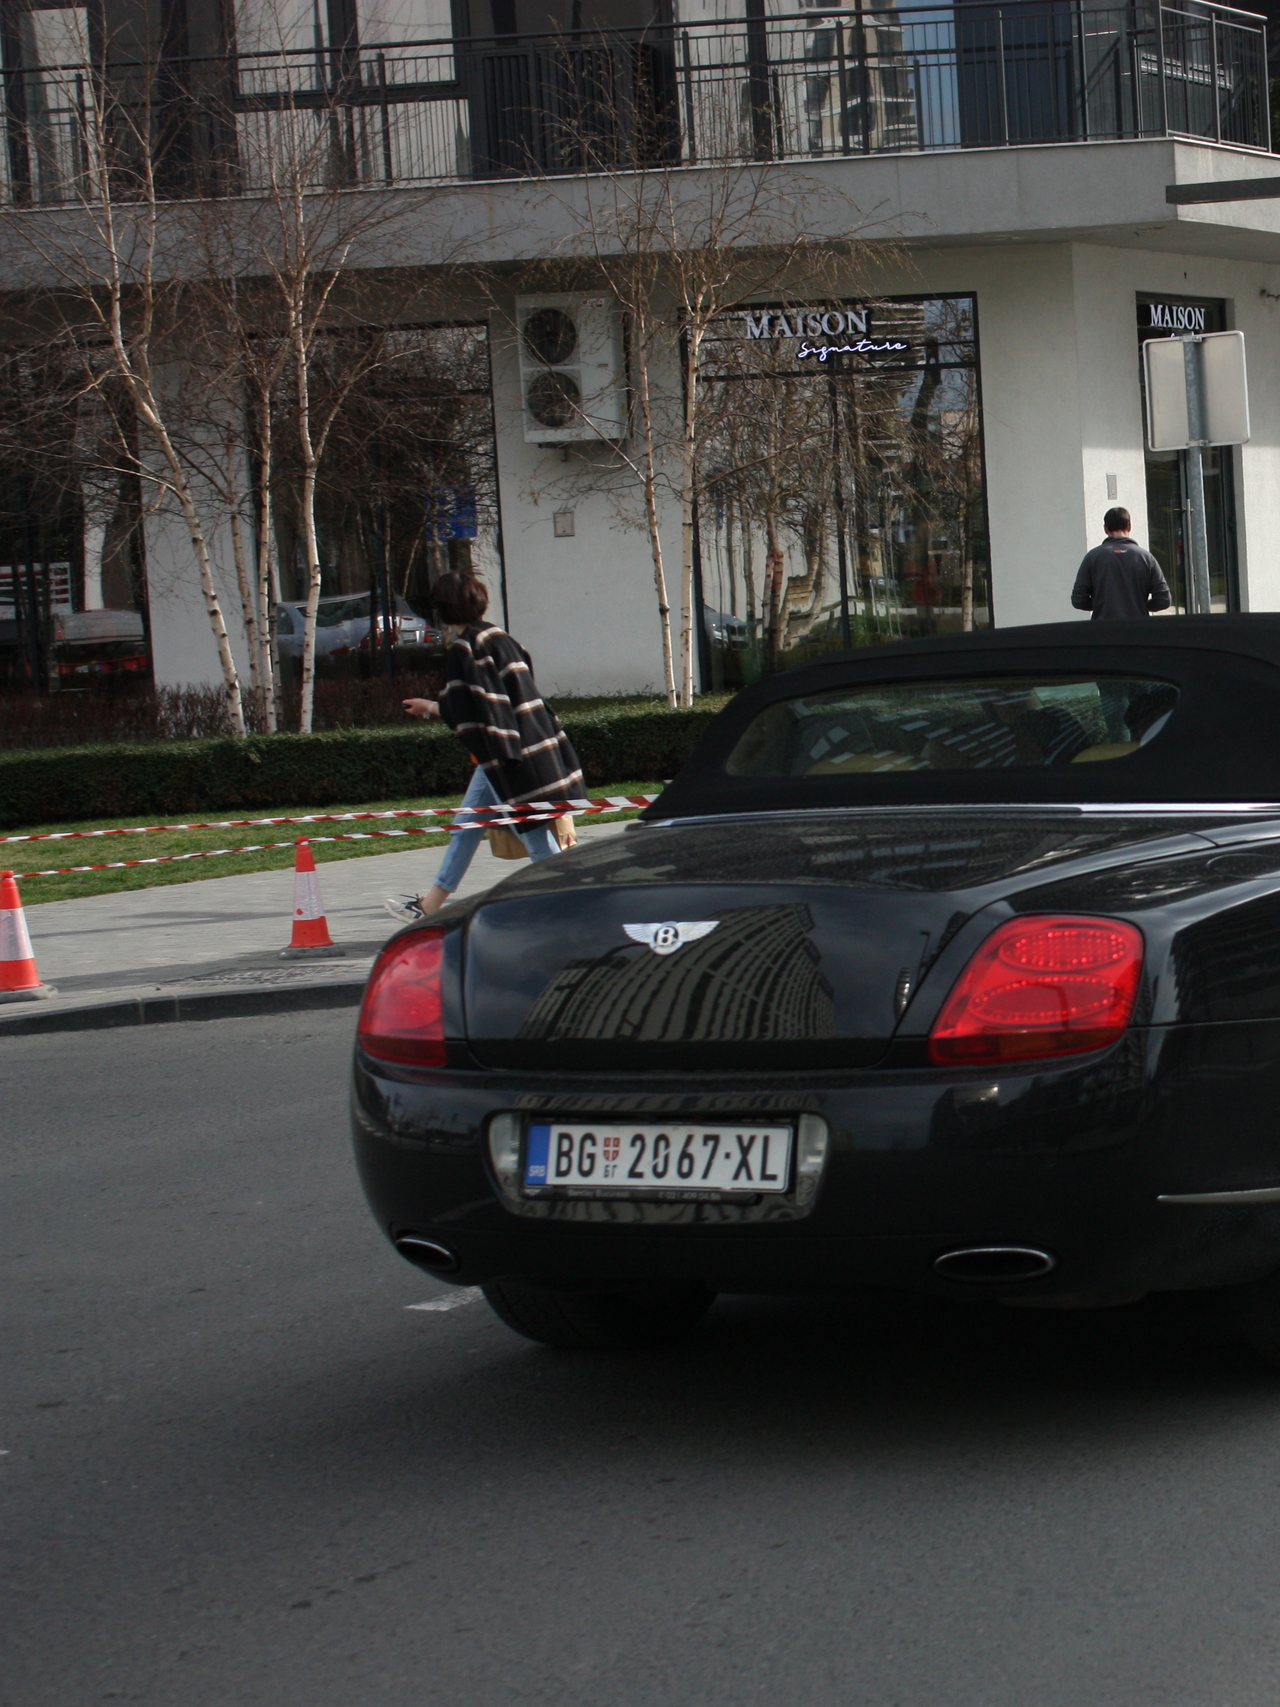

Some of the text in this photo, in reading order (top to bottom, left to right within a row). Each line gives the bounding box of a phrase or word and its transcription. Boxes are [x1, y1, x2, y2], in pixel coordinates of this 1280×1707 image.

[743, 309, 869, 340] MAISON
[1149, 304, 1205, 330] MAISON
[798, 338, 907, 361] Signature
[554, 1132, 597, 1178] BG
